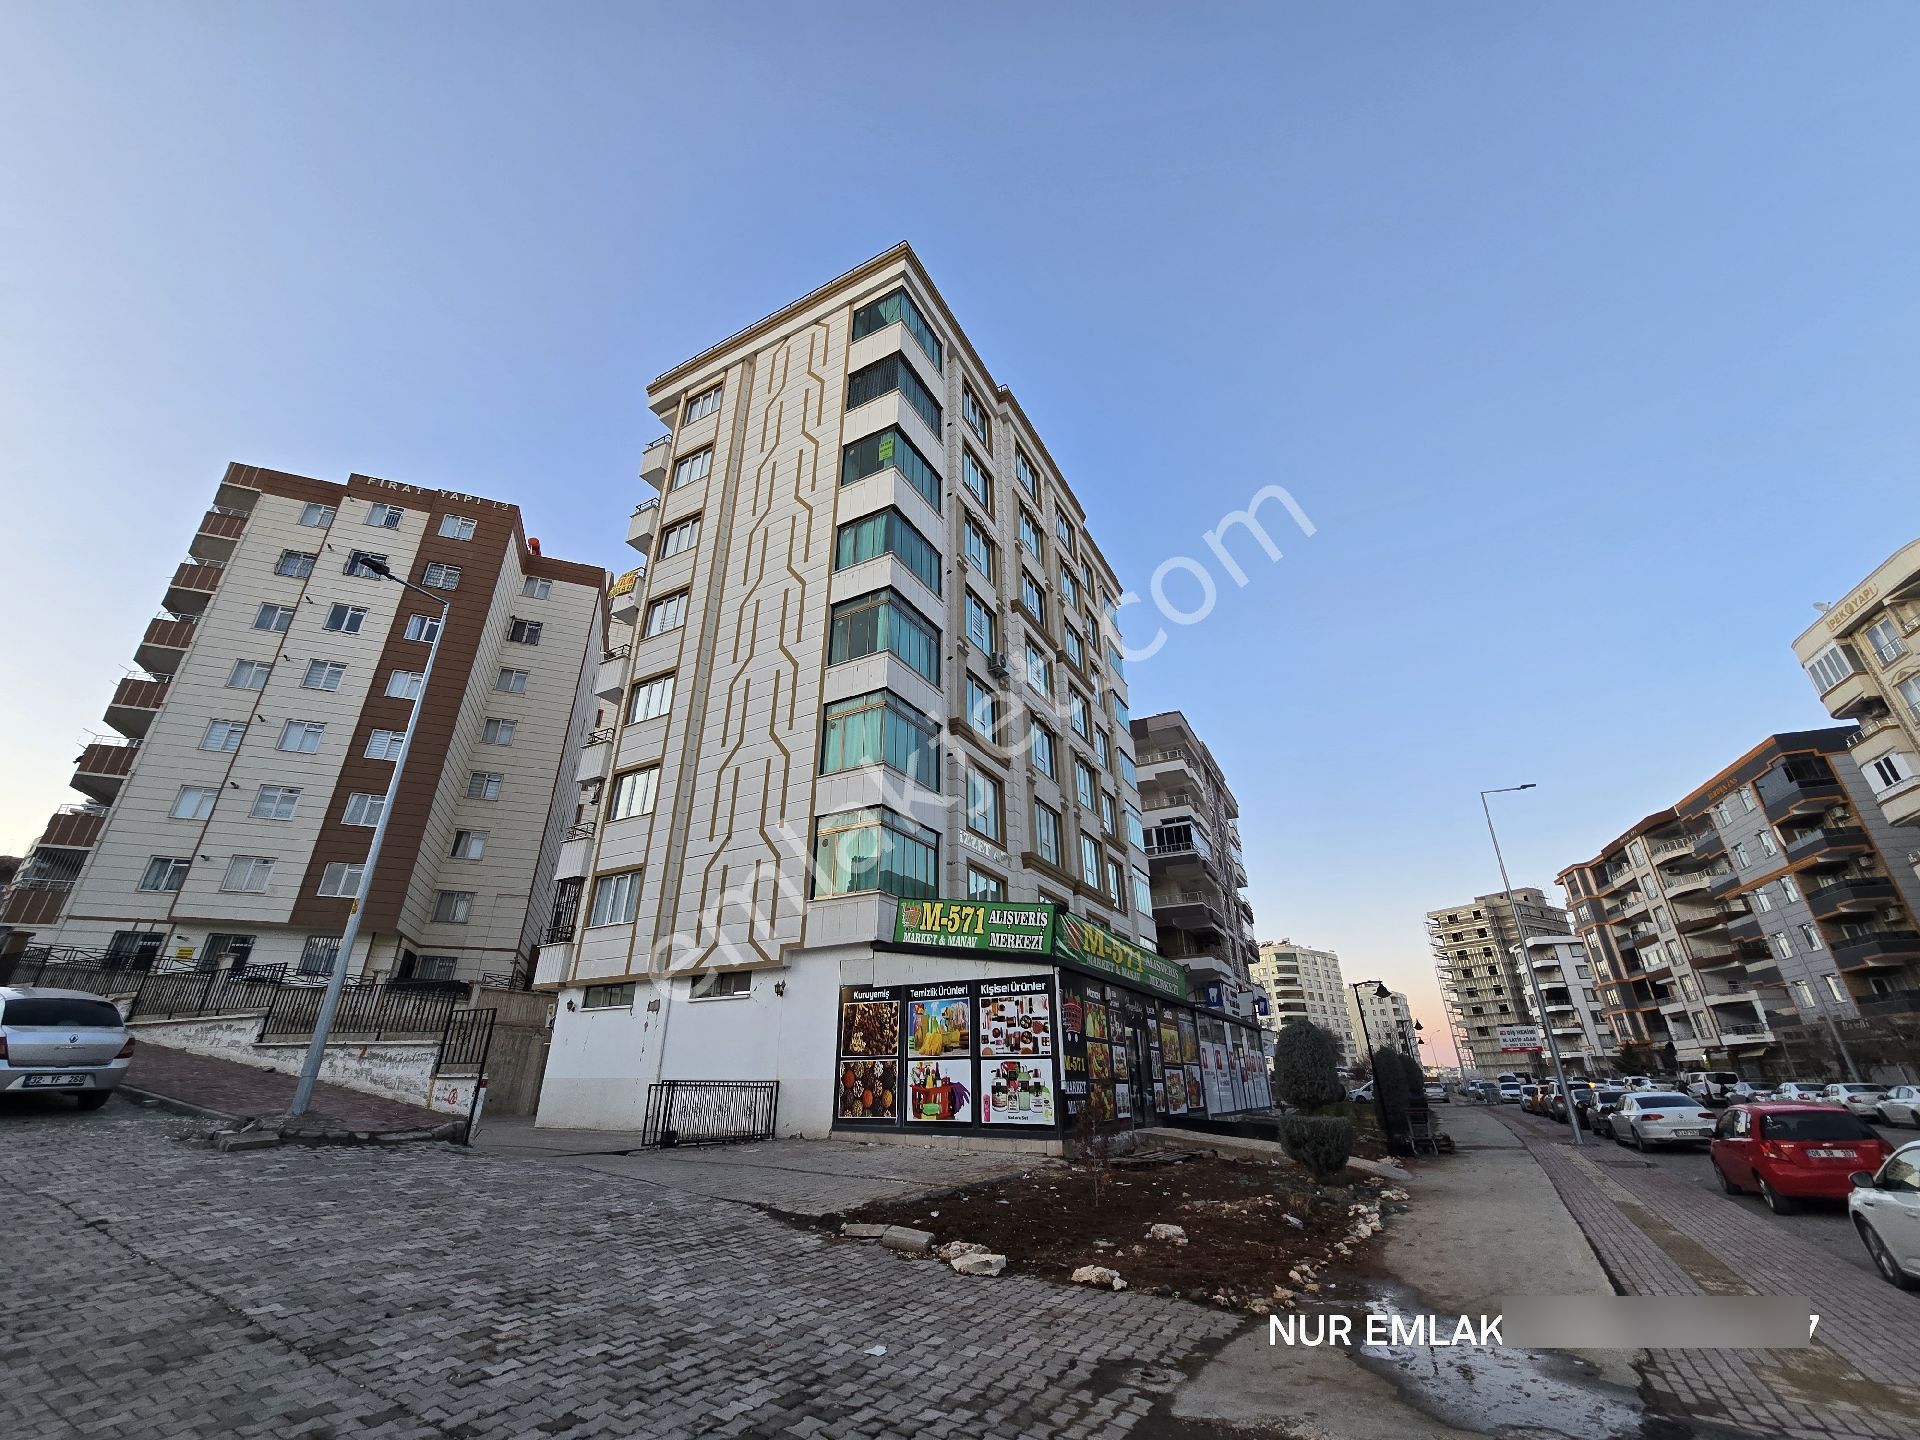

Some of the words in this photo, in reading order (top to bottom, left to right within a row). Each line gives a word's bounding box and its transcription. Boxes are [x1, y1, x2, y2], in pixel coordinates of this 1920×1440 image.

[440, 490, 482, 505] YAPI
[919, 901, 986, 935] M-571
[988, 908, 1048, 932] ALIŞVERİŞ
[902, 932, 938, 945] MARKET
[940, 934, 946, 946] &
[948, 935, 978, 948] MANAV
[989, 930, 1044, 951] MERKEZİ
[1083, 922, 1144, 974] M-571
[853, 989, 890, 1001] Kuruyemiş
[910, 988, 938, 998] Temizlik
[938, 984, 968, 996] Ürünleri
[980, 983, 1010, 996] Kişisel
[1010, 981, 1046, 993] Ürünler
[1064, 1055, 1086, 1071] M-571
